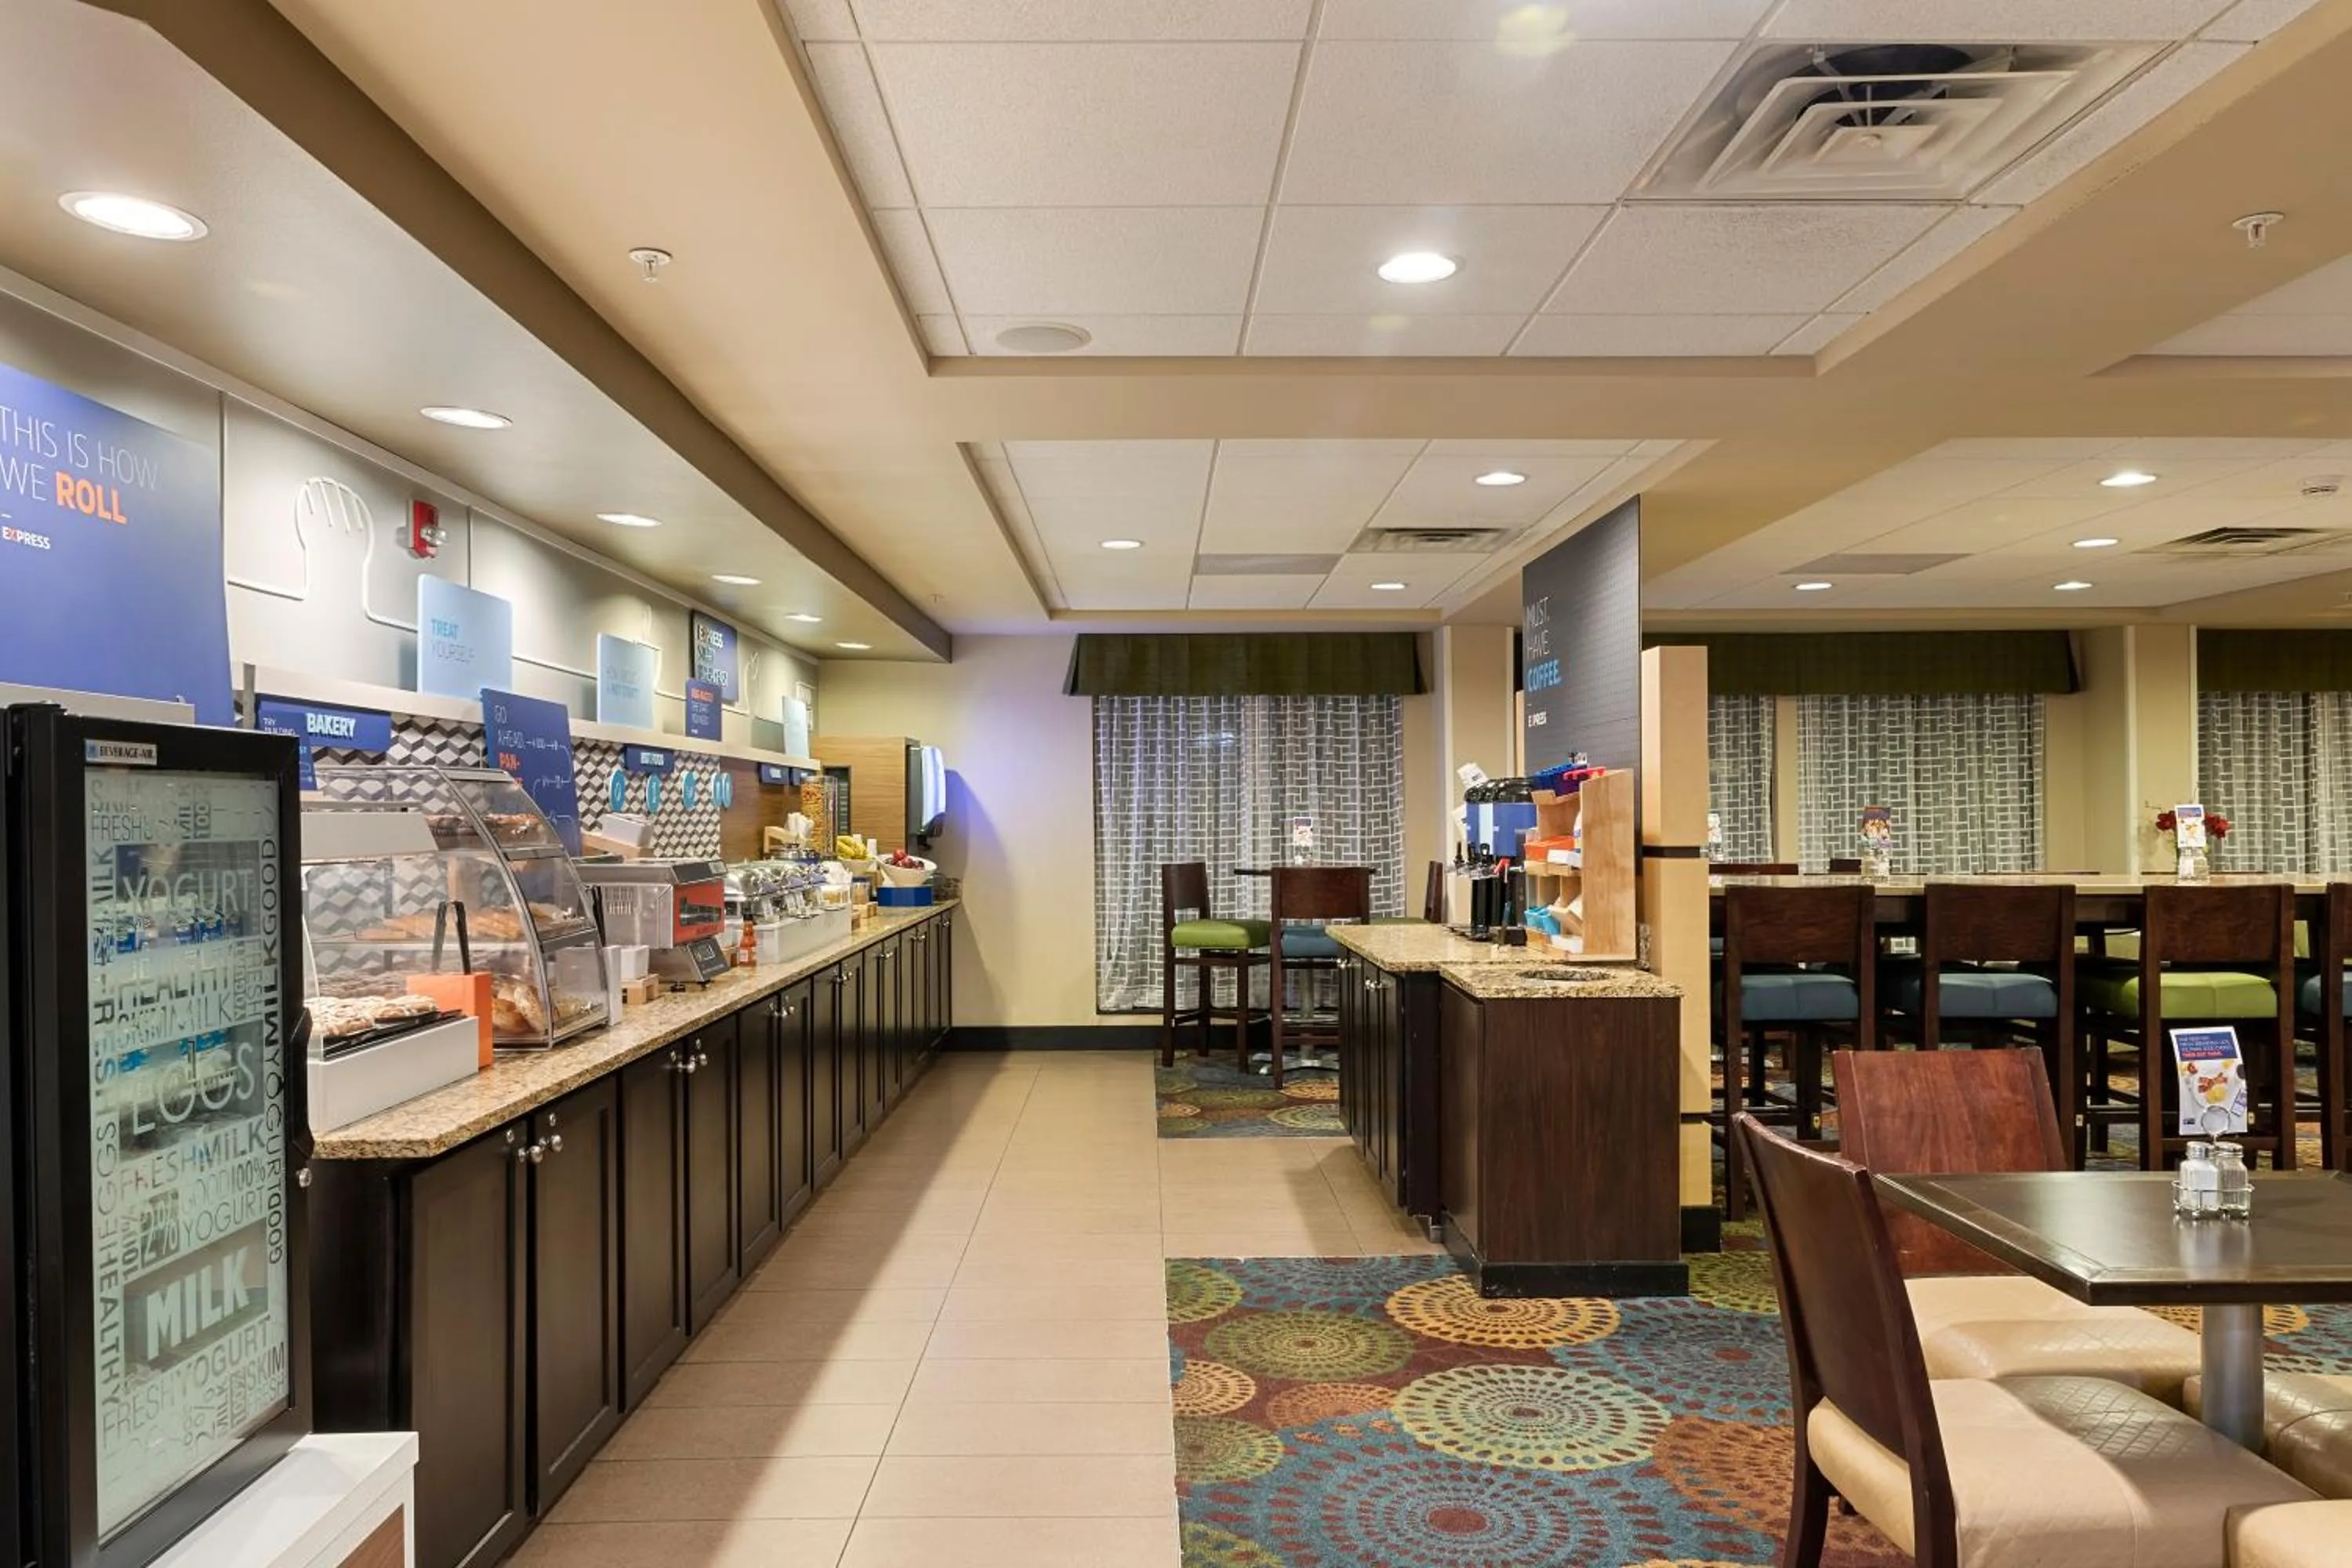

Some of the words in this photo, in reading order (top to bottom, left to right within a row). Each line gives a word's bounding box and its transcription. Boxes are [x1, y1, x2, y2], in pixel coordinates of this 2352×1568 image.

[0, 405, 57, 459] THIS
[67, 430, 89, 469] IS
[98, 440, 158, 491] HOW
[0, 455, 47, 501] WE
[56, 470, 127, 525] ROLL
[2, 526, 51, 550] EXPRESS
[431, 618, 459, 640] TREAT
[1526, 596, 1551, 628] MUST
[1527, 630, 1550, 661] HAVE
[306, 713, 356, 737] BAKERY
[122, 869, 256, 925] YOGURT
[261, 839, 278, 936] GOOD
[263, 940, 279, 1048] MILK
[131, 1042, 256, 1136] EGGS
[182, 1185, 265, 1248] YOGURT
[267, 1192, 283, 1265] GOOD
[99, 1242, 121, 1406] HEALTHY
[146, 1245, 250, 1362] MILK
[102, 1374, 175, 1450] FRESH
[176, 1314, 271, 1398] YOGURT
[246, 1341, 285, 1392] SKIM
